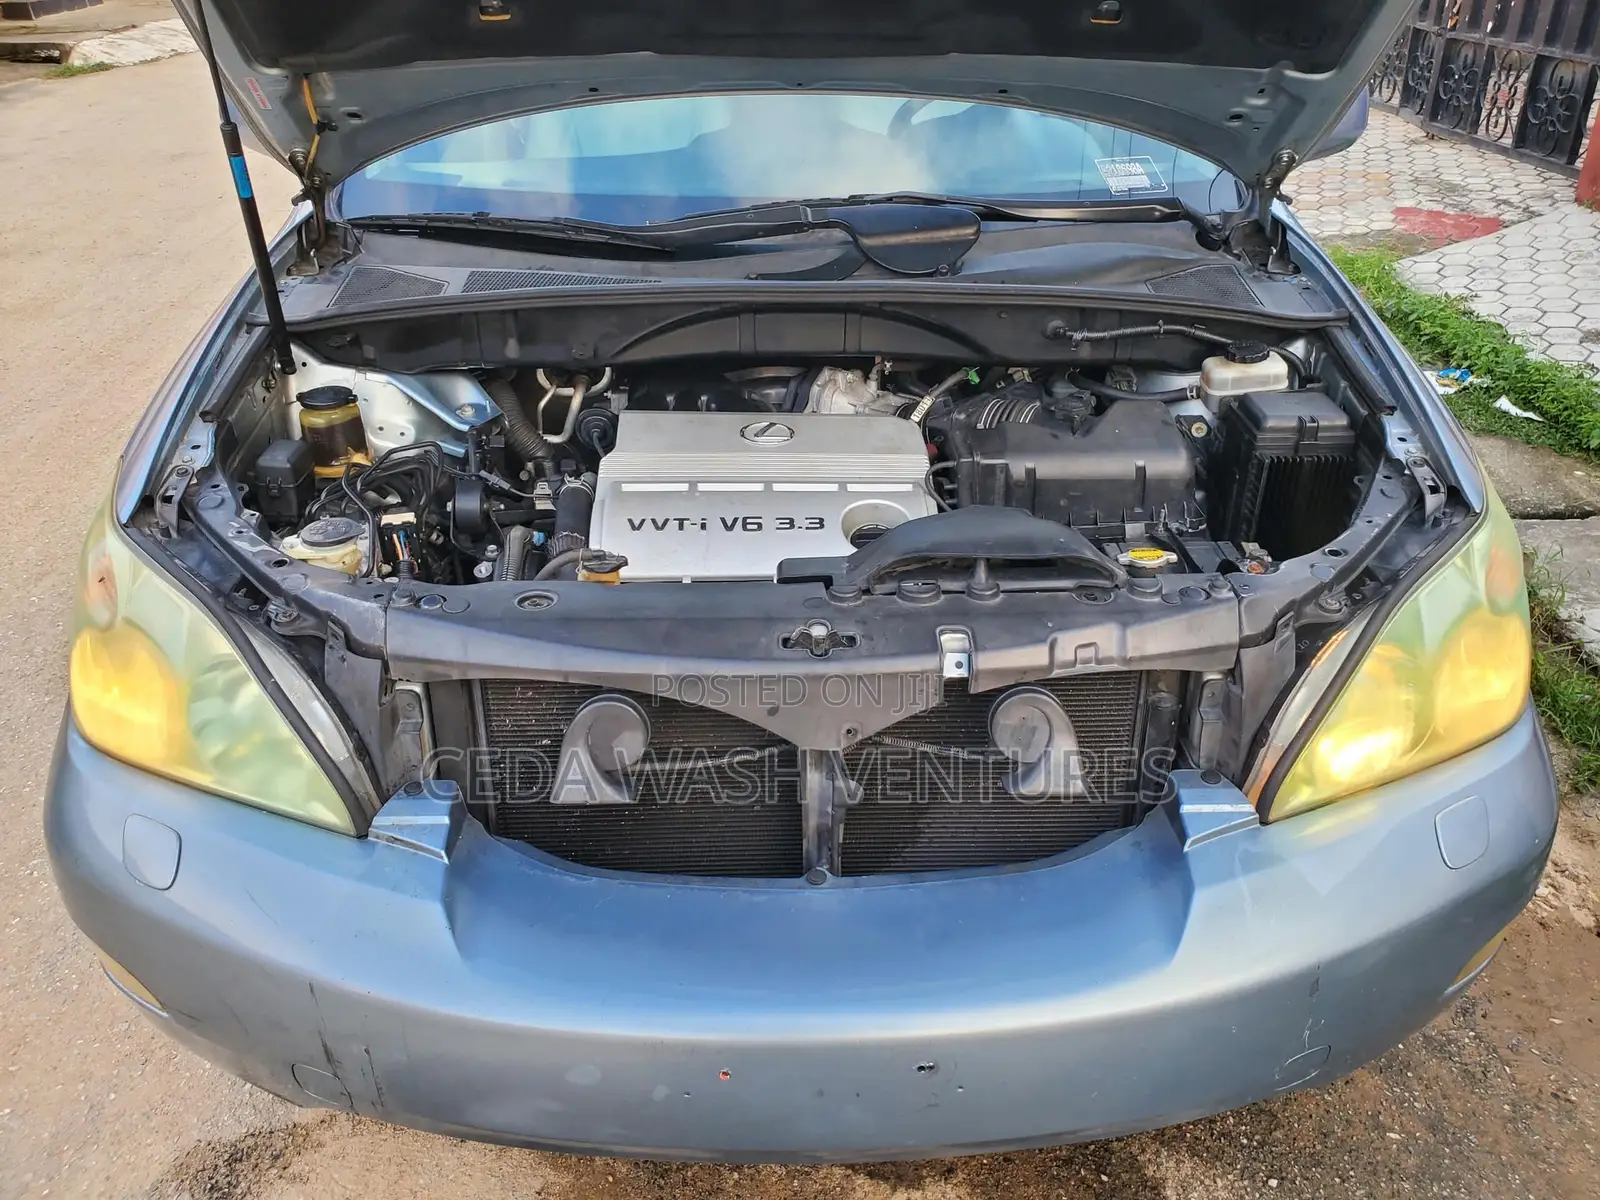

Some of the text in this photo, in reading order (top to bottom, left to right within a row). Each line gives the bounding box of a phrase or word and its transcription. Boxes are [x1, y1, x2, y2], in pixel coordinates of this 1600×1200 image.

[627, 516, 826, 532] VVT-i V6 3.3
